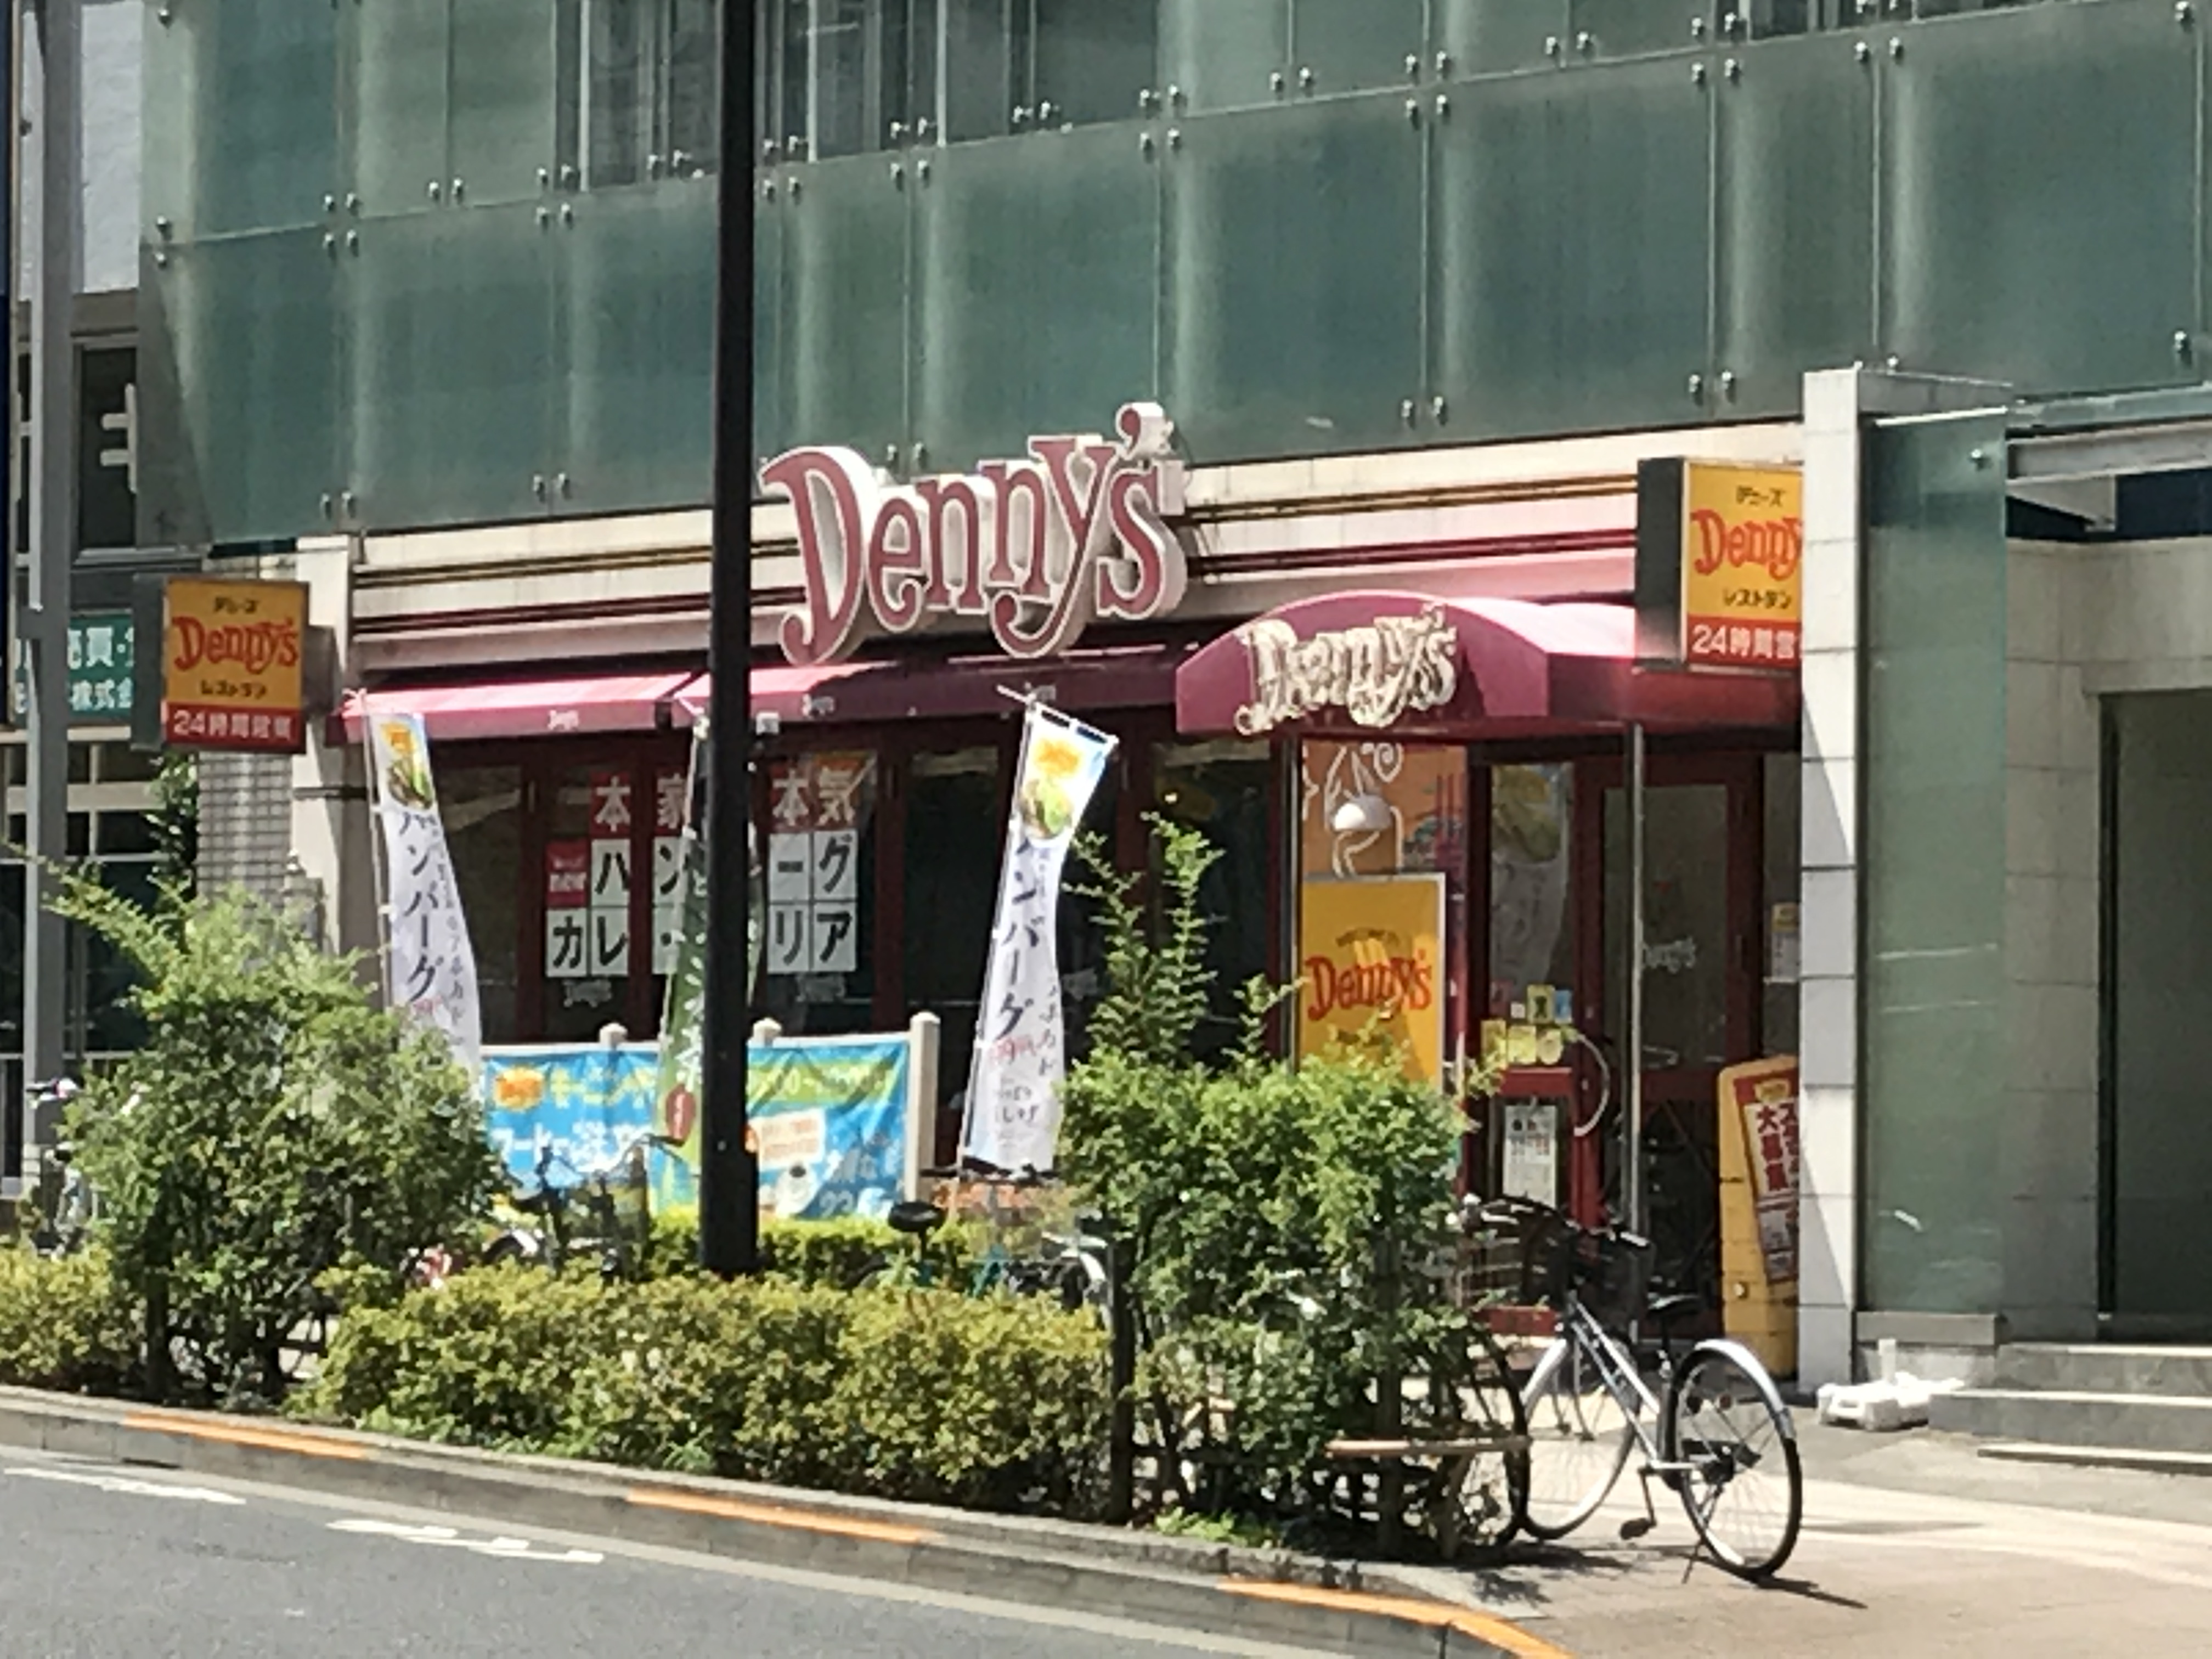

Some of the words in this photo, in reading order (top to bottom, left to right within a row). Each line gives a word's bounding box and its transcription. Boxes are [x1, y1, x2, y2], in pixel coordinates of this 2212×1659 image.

[759, 404, 1180, 666] Denny's
[1690, 509, 1802, 582] Denny
[171, 616, 298, 675] Denny's
[1234, 603, 1457, 735] Denny's
